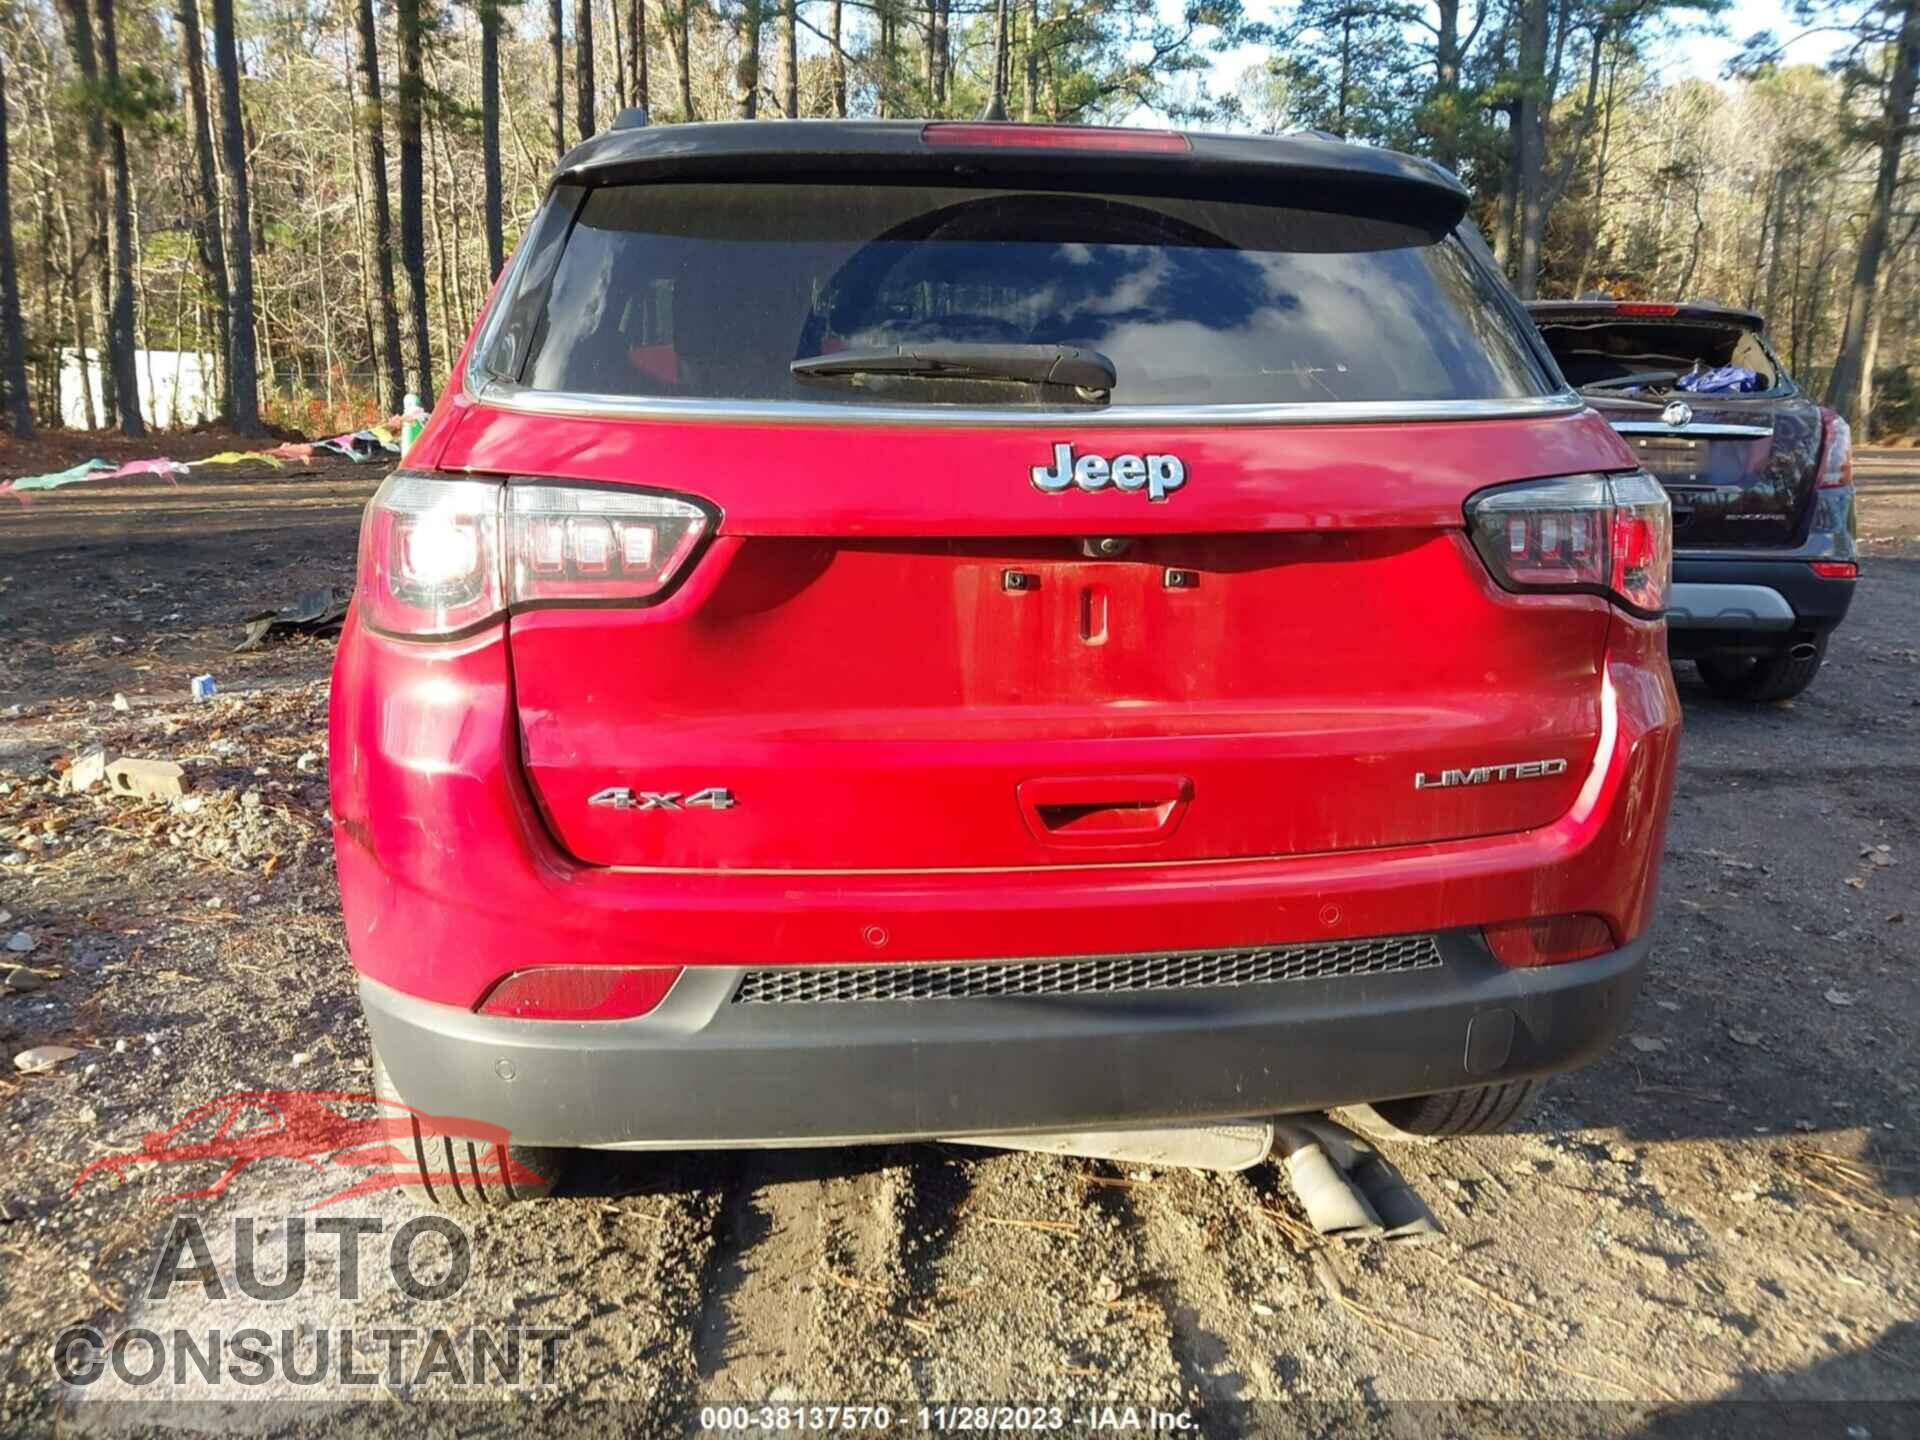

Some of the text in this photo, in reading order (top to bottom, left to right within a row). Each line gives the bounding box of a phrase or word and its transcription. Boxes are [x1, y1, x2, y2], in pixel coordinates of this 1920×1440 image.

[1031, 443, 1186, 500] Jeep
[1415, 758, 1567, 790] LIMITED
[587, 787, 735, 811] 4x4
